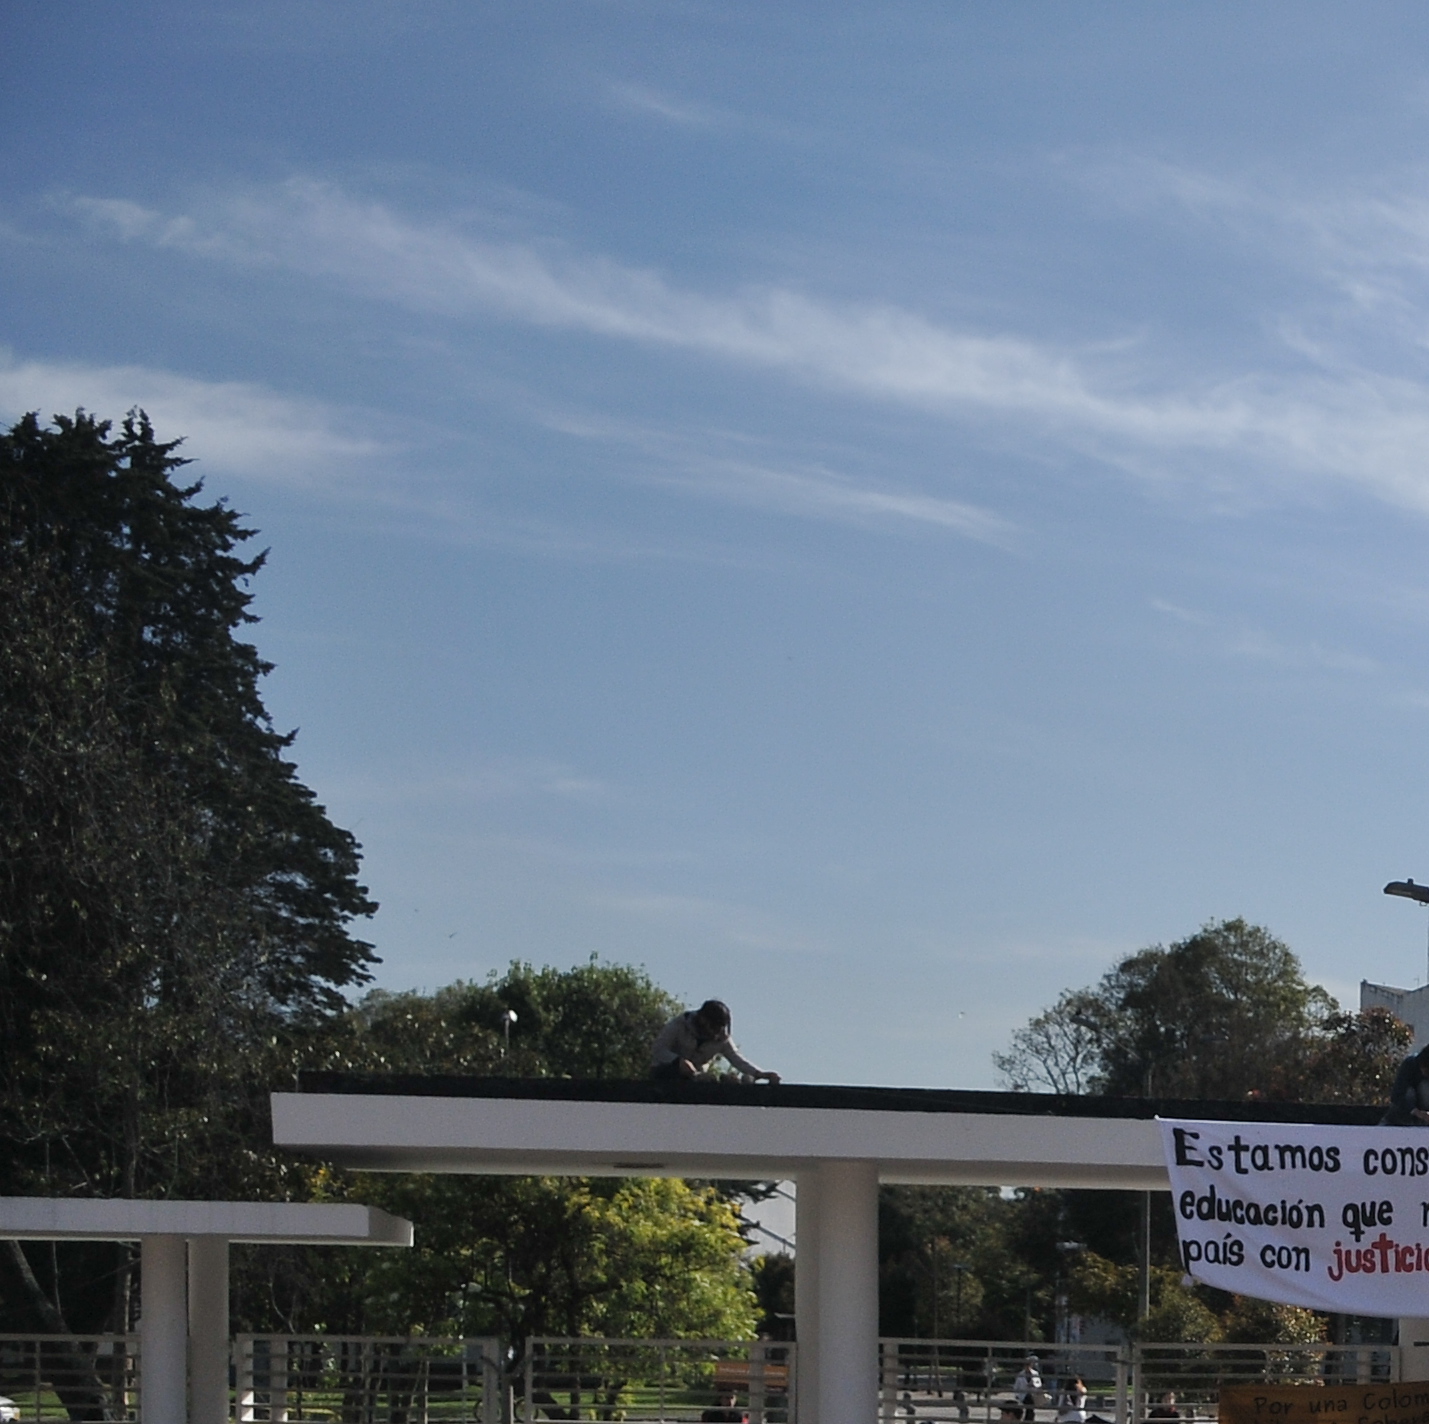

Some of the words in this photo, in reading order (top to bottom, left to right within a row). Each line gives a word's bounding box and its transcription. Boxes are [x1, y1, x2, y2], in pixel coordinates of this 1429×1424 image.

[1172, 1127, 1341, 1173] Estamos
[1180, 1185, 1325, 1229] educación
[1342, 1199, 1393, 1242] que
[1182, 1232, 1245, 1275] país
[1260, 1244, 1310, 1272] con
[1254, 1397, 1294, 1415] Por
[1310, 1397, 1348, 1414] una
